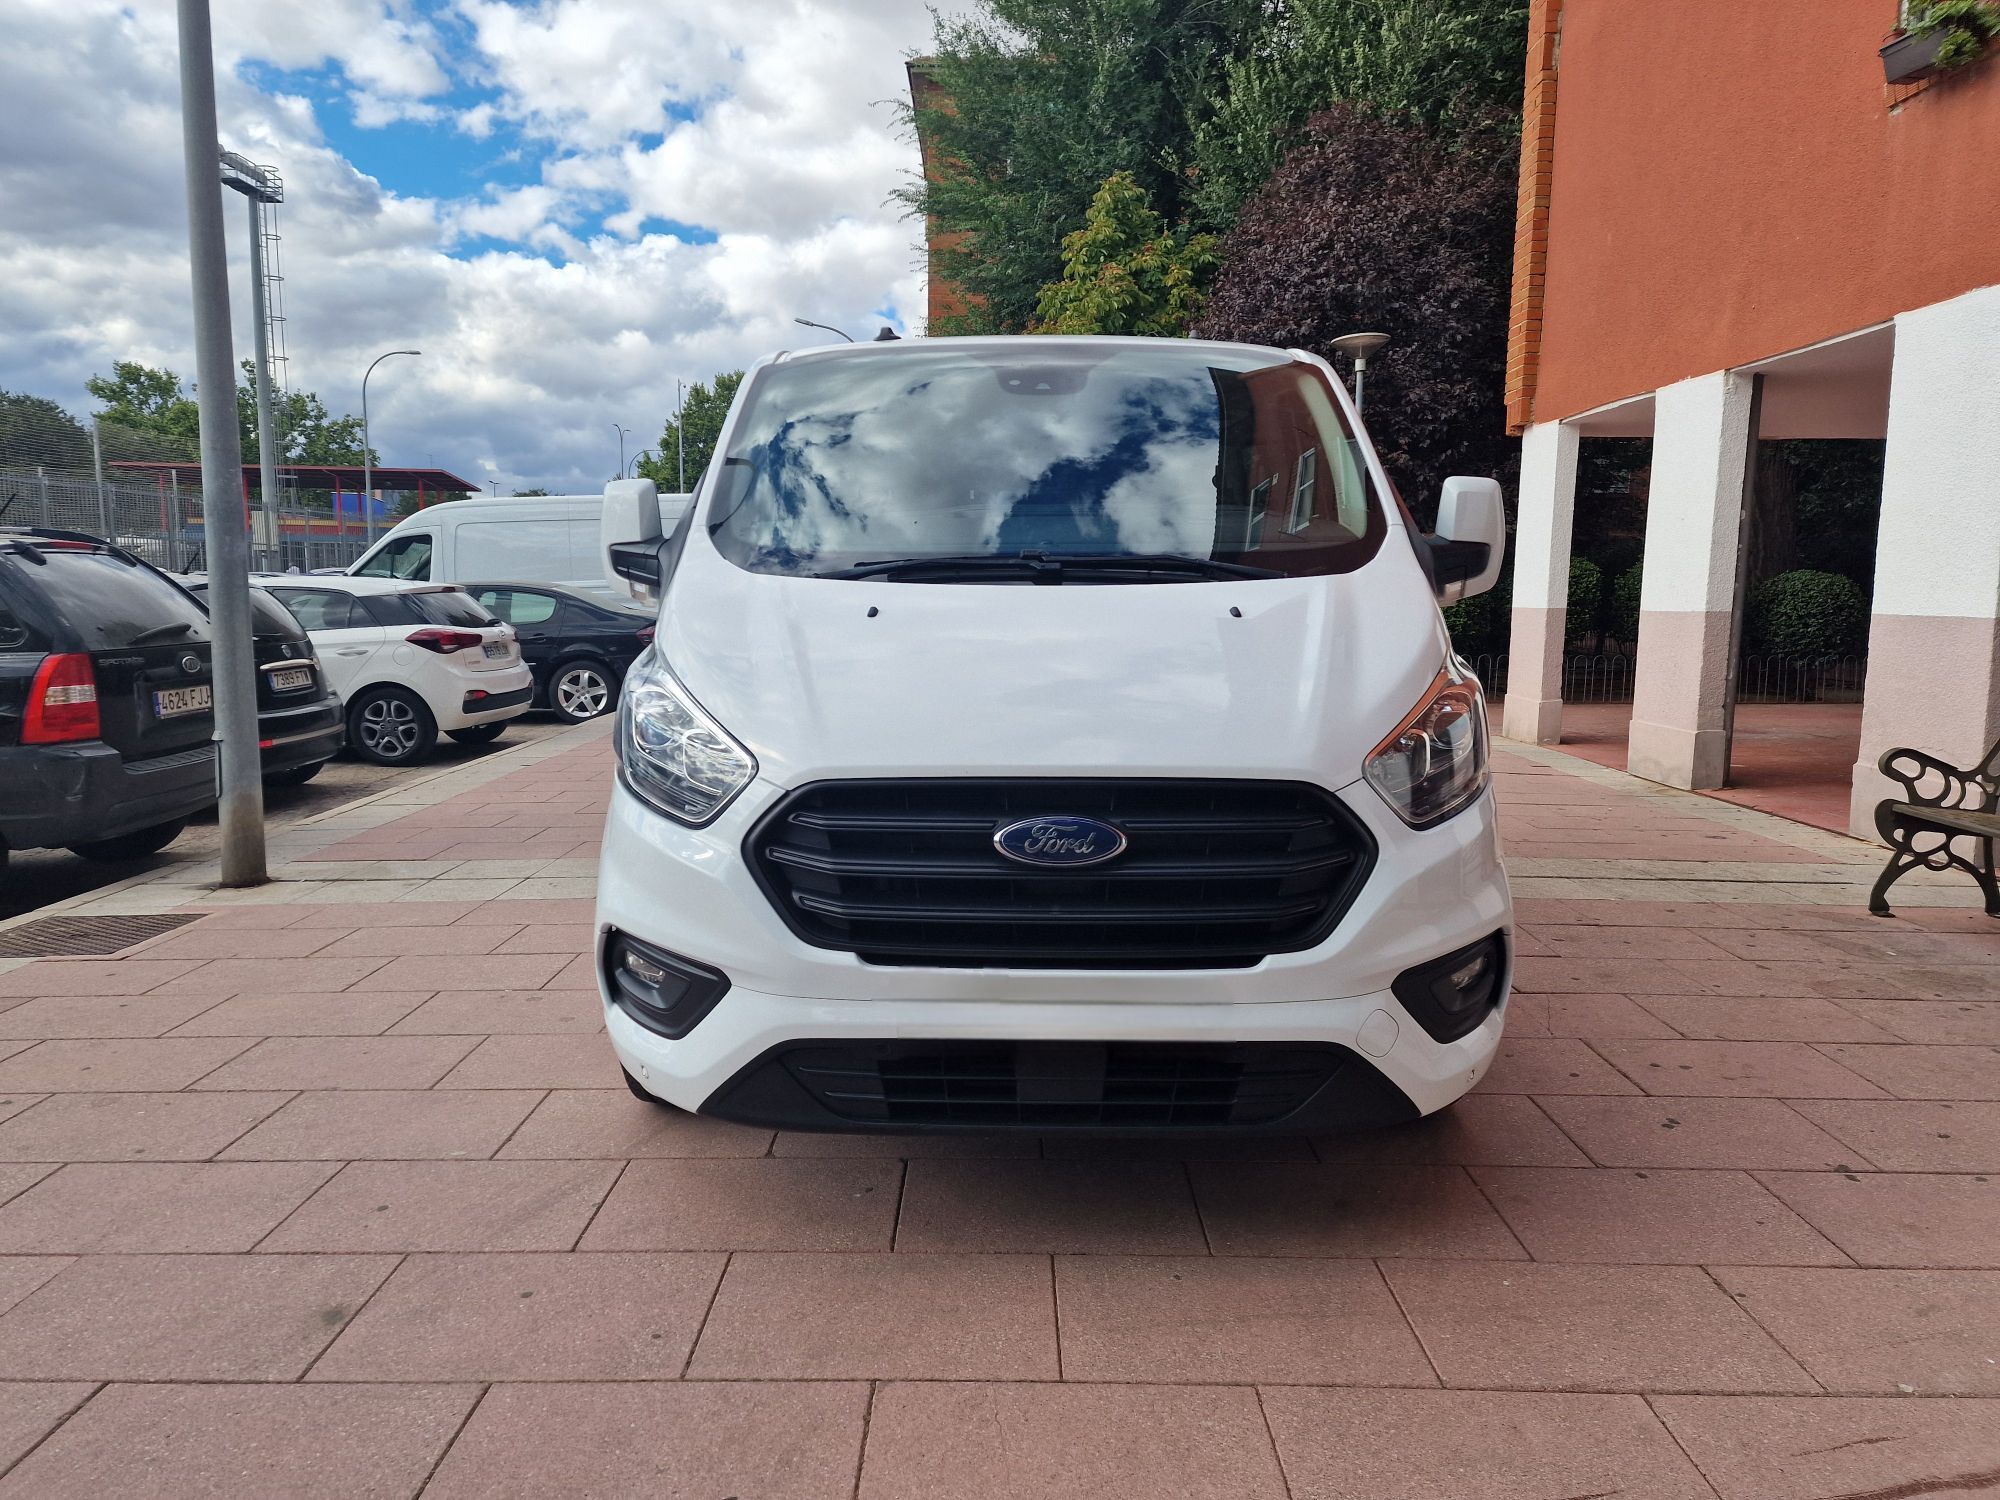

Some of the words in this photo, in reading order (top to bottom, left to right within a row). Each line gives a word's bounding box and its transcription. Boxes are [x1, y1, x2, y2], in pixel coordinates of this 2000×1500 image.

[274, 671, 295, 687] 7389
[160, 692, 187, 711] 4624
[1024, 824, 1096, 853] Ford
